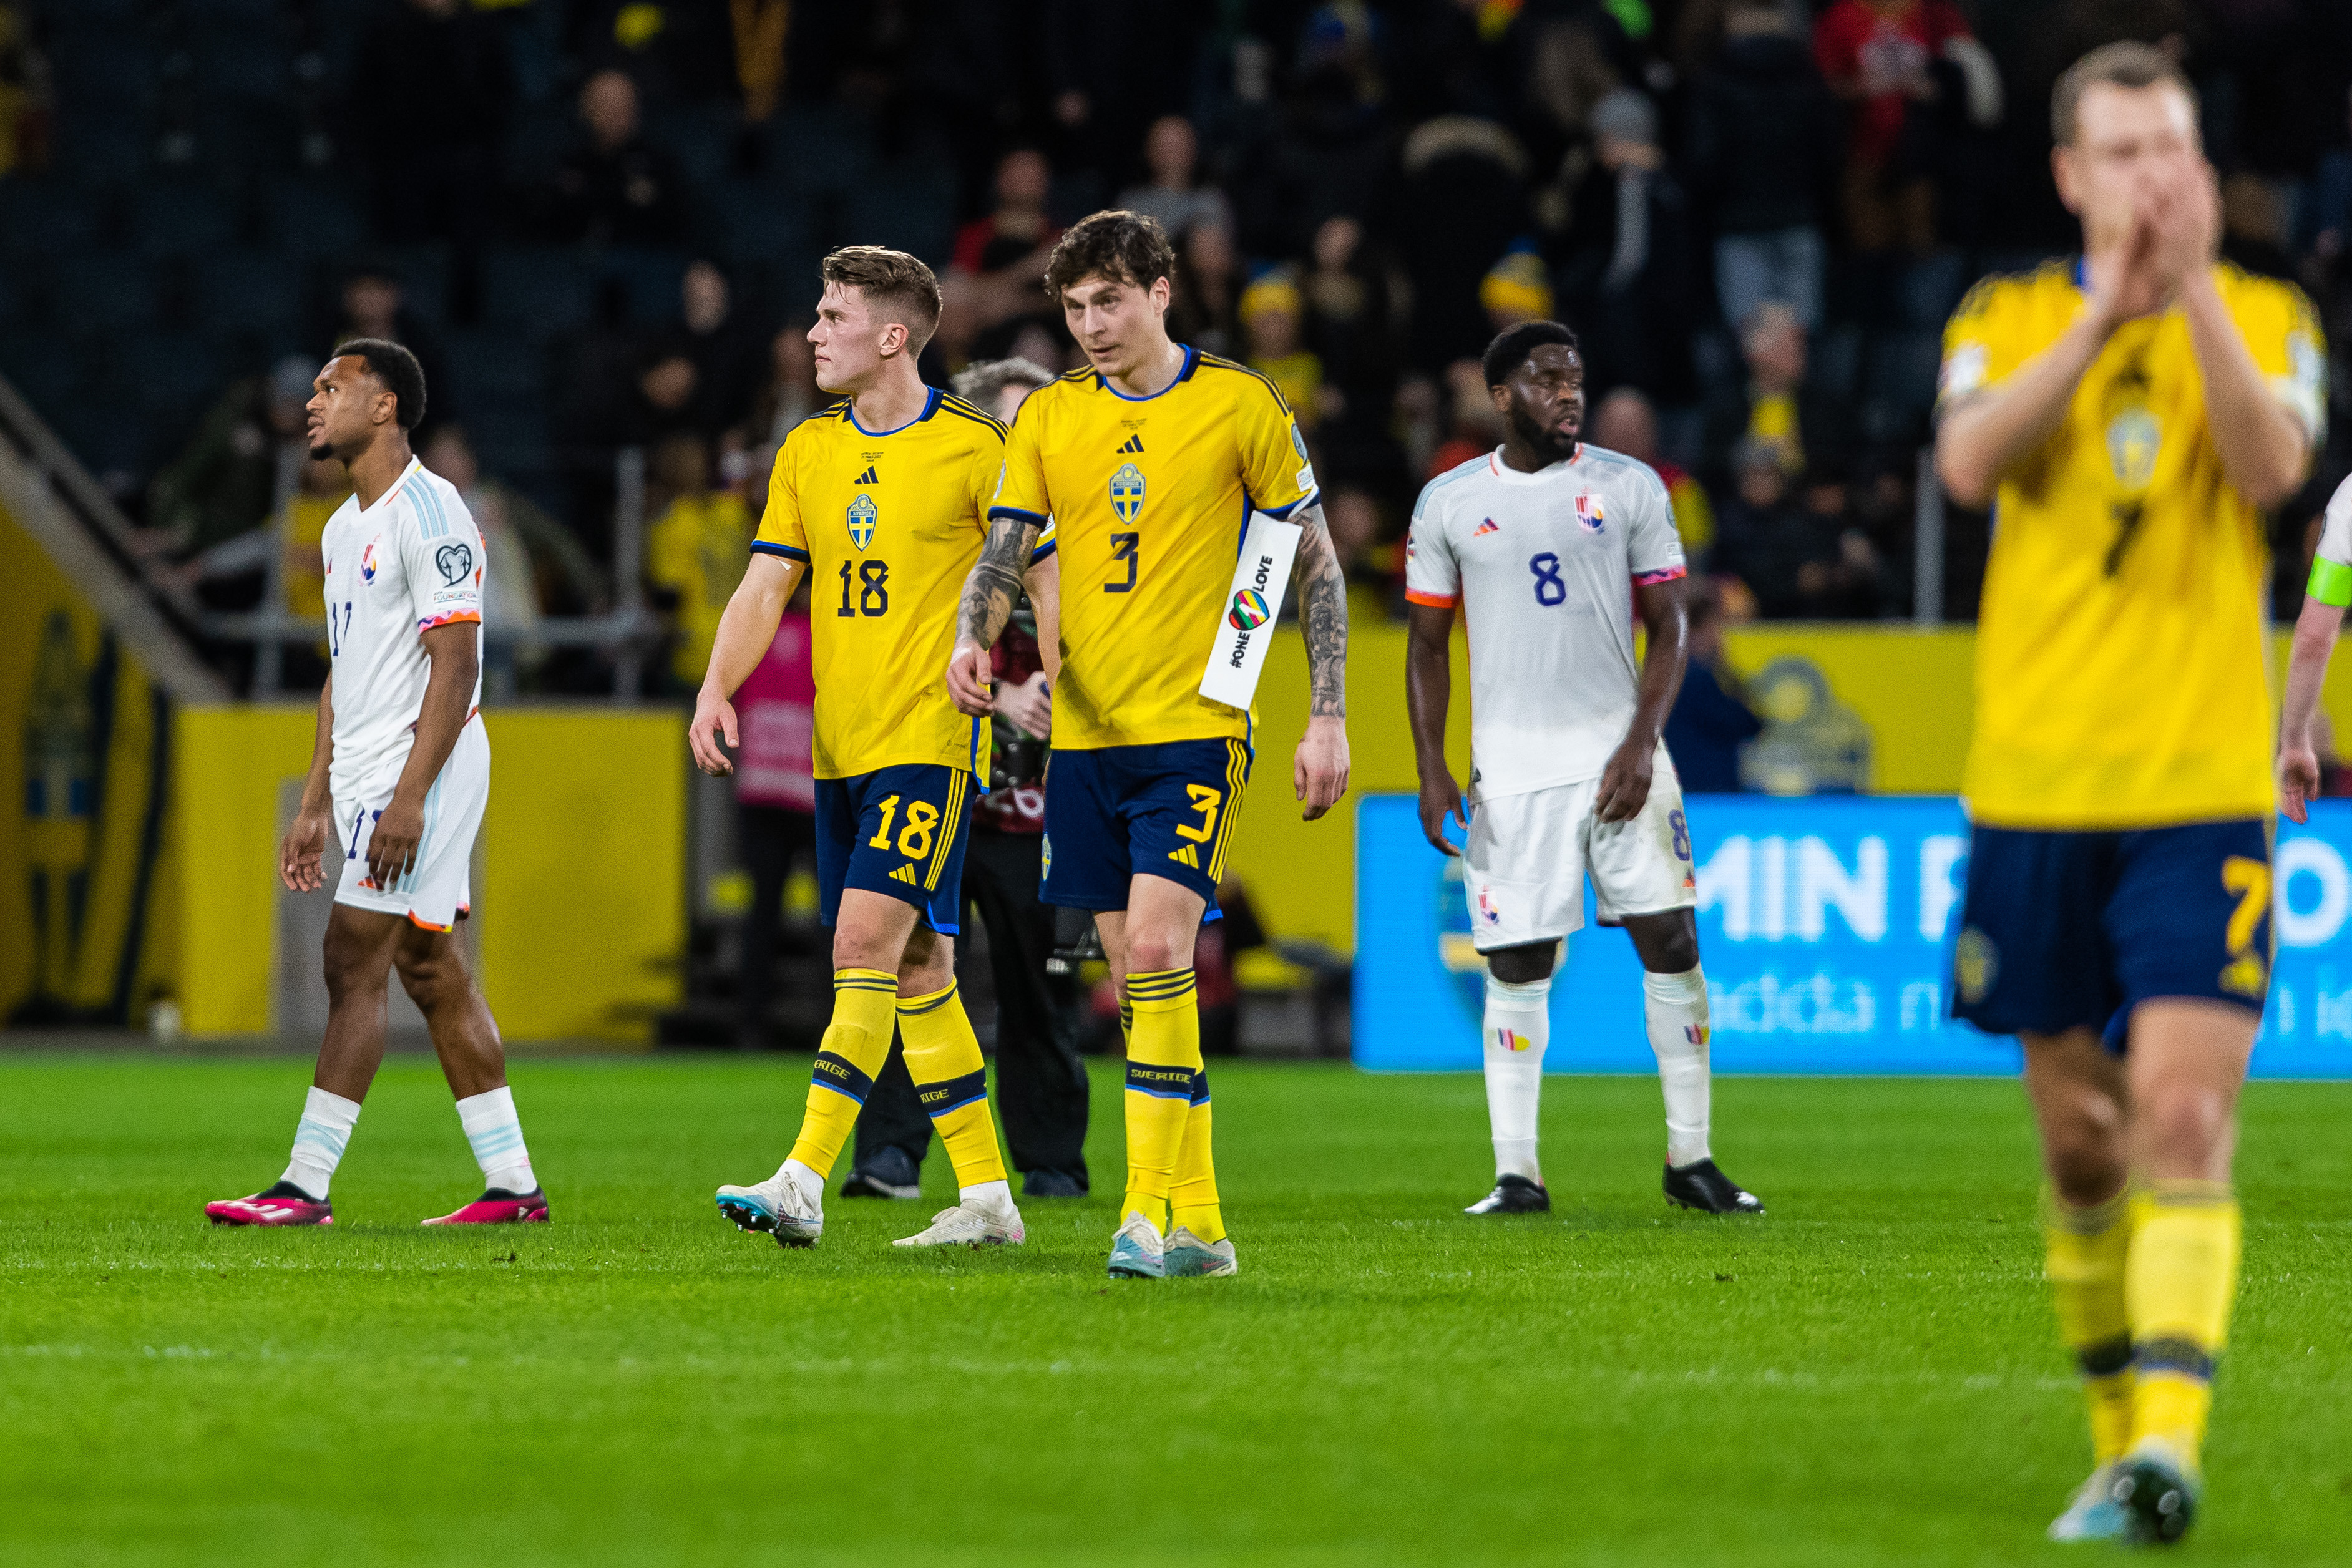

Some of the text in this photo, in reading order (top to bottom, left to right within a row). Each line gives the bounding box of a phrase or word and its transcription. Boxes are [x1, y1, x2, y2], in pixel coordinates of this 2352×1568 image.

[1103, 532, 1139, 593] 3
[2102, 501, 2145, 578] 7
[837, 560, 889, 618] 18
[1252, 555, 1273, 592] LOVE
[1529, 552, 1566, 606] 8
[332, 601, 352, 657] 17
[1229, 631, 1251, 668] #ONE
[869, 794, 940, 860] 18
[1176, 783, 1222, 844] 3
[1668, 809, 1691, 862] 8
[2220, 854, 2273, 957] 7
[1131, 1069, 1191, 1084] SVERIGE
